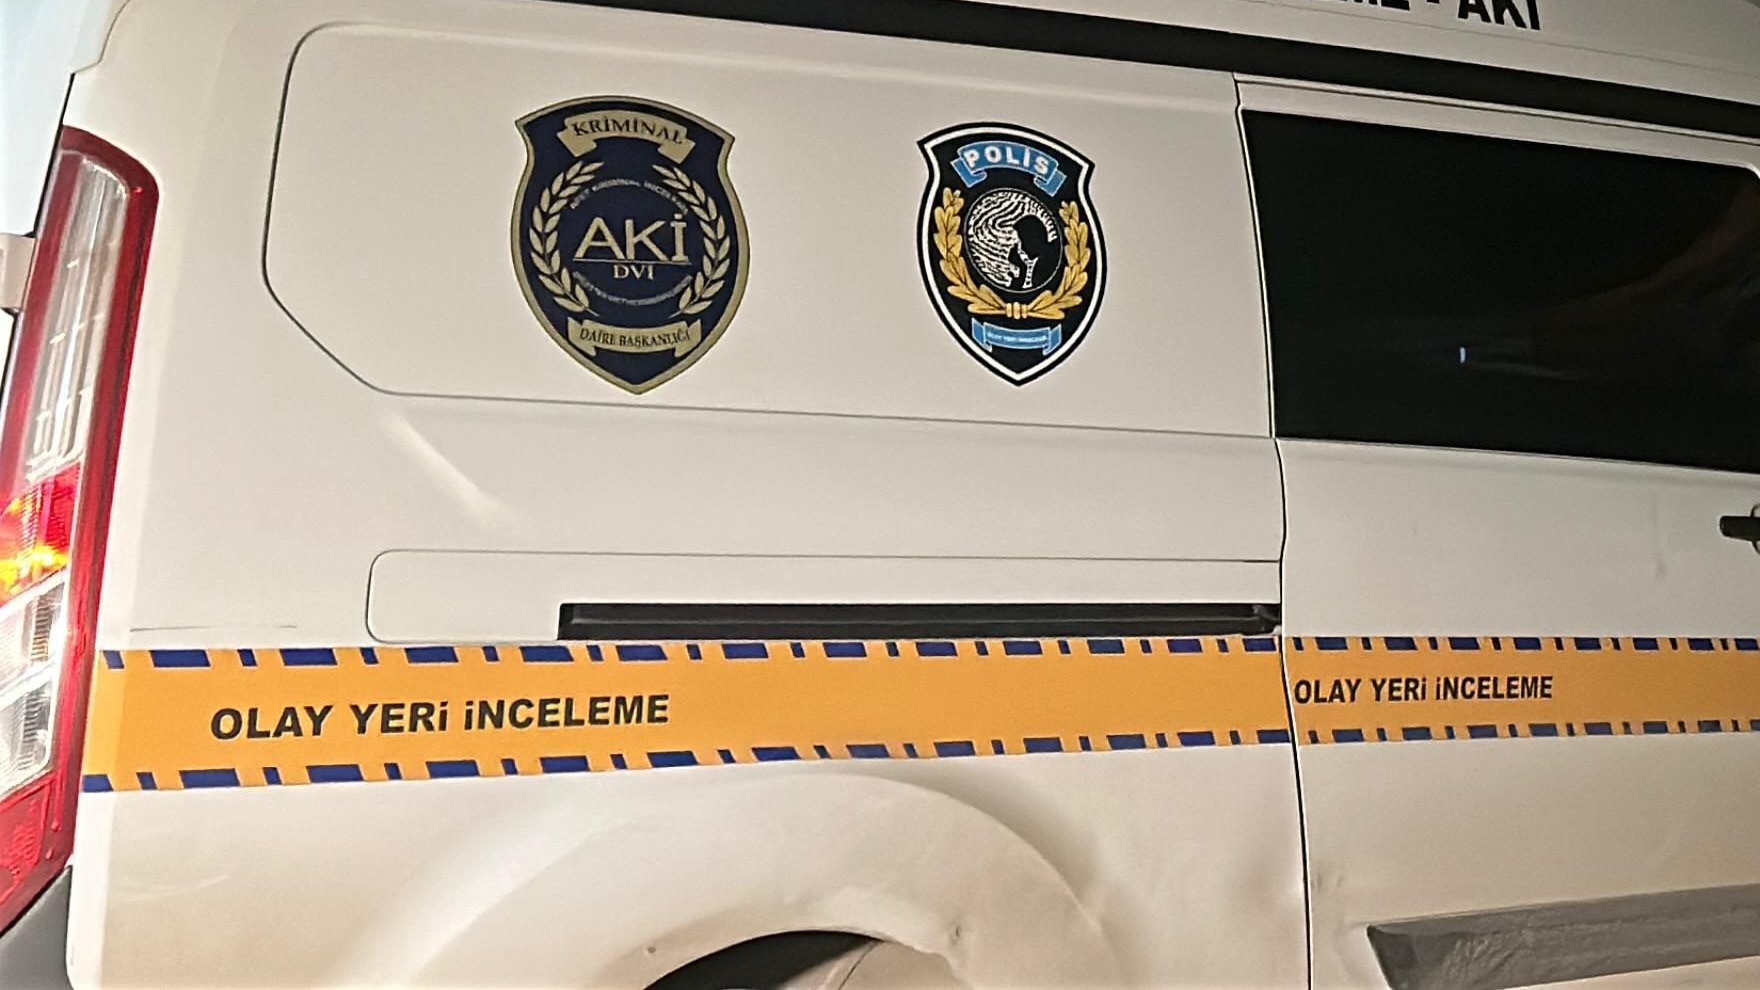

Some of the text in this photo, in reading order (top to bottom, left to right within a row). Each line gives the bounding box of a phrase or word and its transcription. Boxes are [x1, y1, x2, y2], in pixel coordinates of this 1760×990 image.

[572, 115, 683, 145] KRİMİNAL
[575, 213, 688, 261] AKİ
[1294, 678, 1362, 704] OLAY
[210, 704, 334, 740] OLAY
